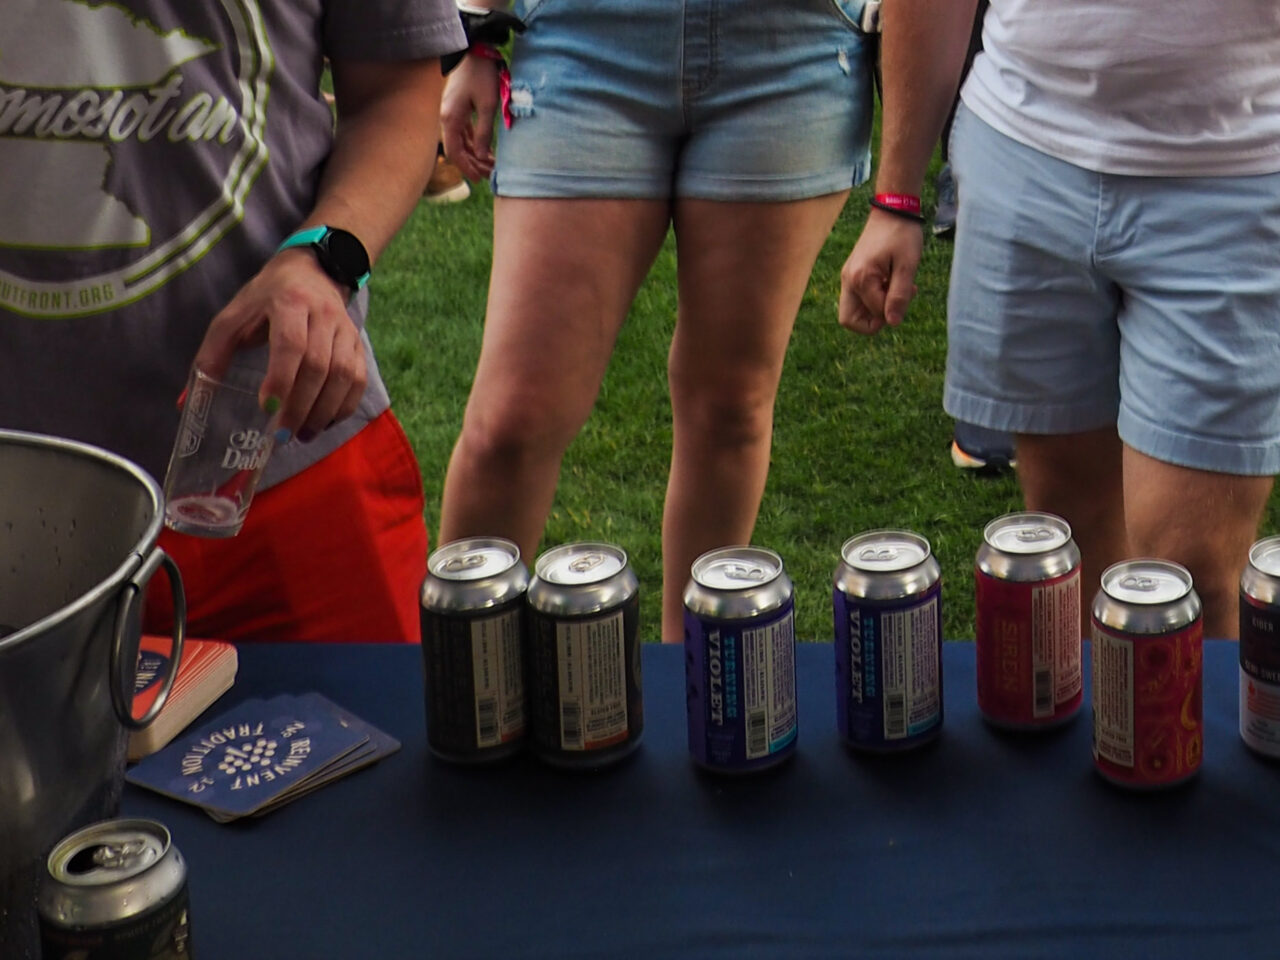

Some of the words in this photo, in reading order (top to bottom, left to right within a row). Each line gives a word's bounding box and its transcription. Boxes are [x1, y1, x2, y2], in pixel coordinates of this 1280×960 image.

[0, 281, 115, 310] UTFRONT.ORG
[709, 630, 723, 726] VIOLET
[850, 609, 863, 704] VIOLET
[182, 722, 264, 775] TRADITION
[231, 737, 311, 790] REINVENT
